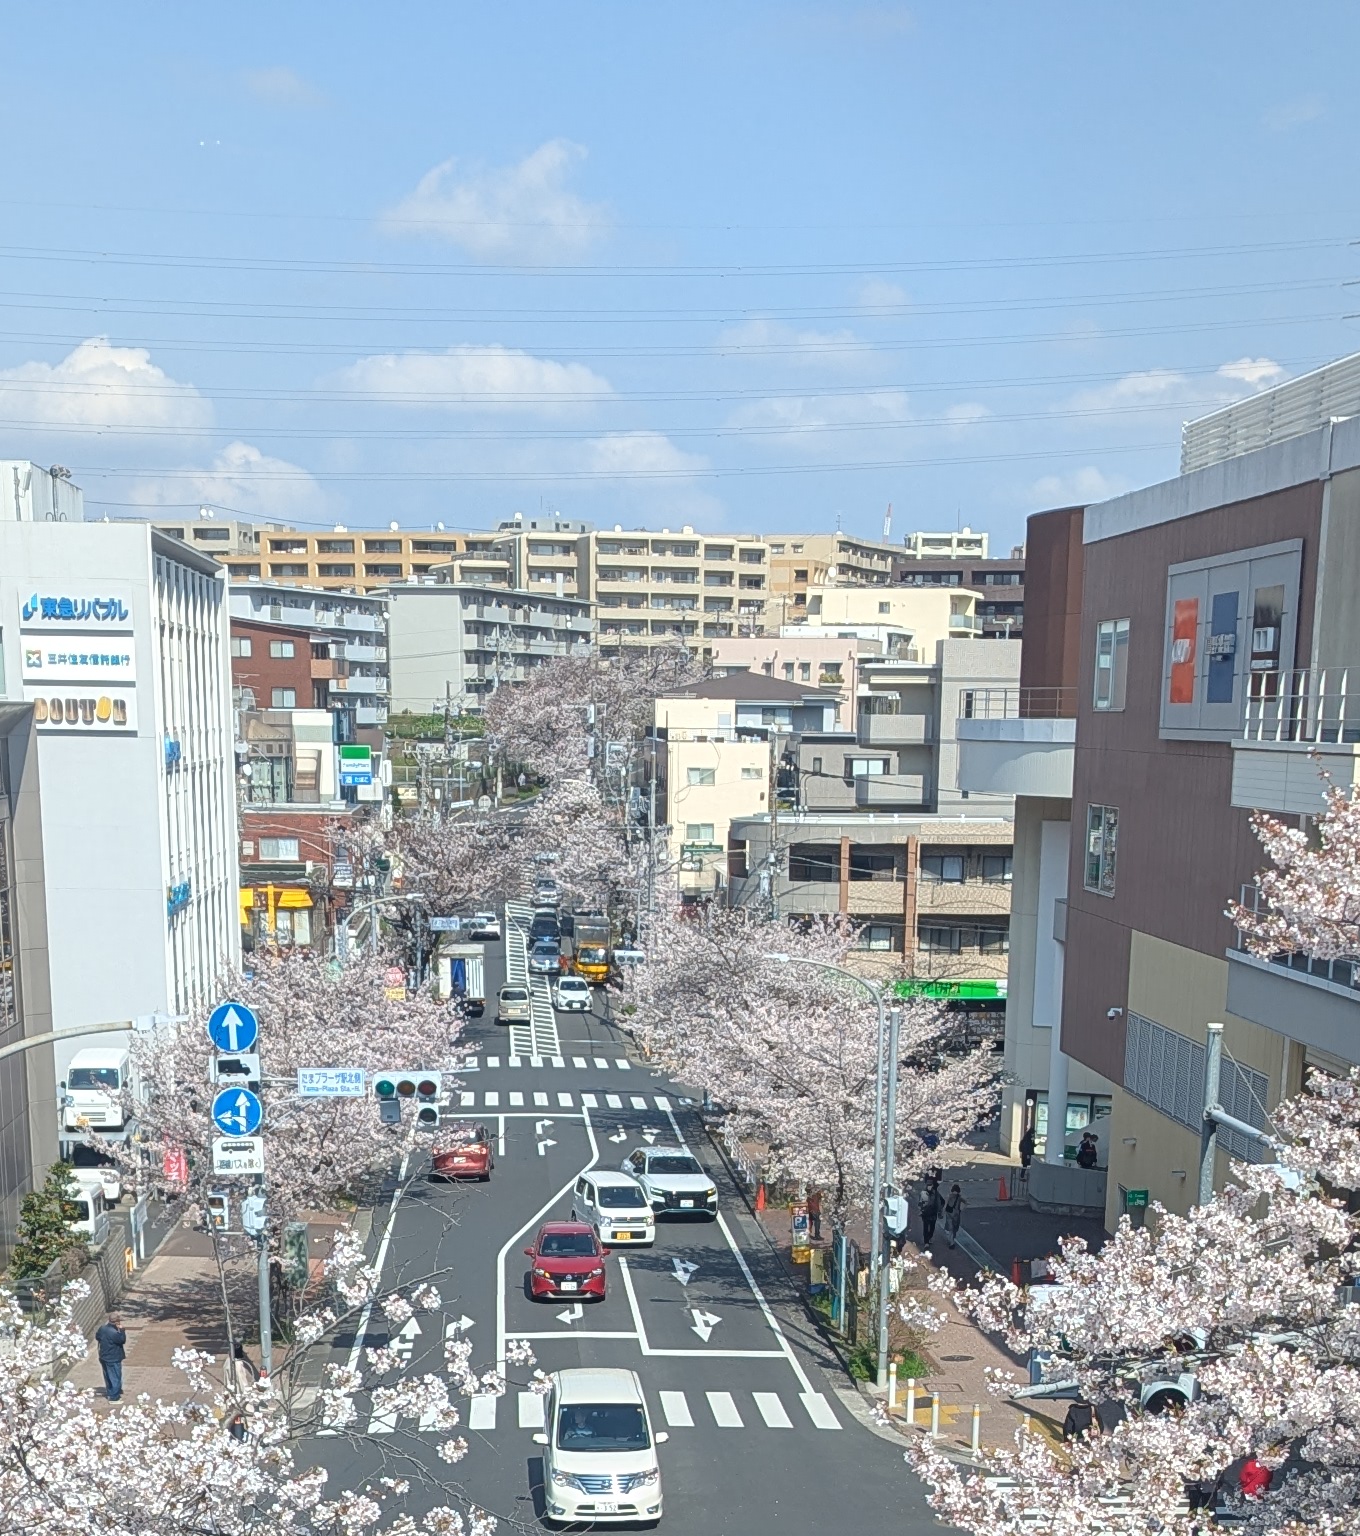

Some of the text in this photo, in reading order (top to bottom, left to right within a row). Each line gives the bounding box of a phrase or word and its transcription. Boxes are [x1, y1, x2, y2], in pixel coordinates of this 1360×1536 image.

[40, 597, 129, 621] 東急リバブル
[47, 653, 130, 667] 三井住友信託銀行
[33, 696, 127, 725] DOUTOR
[301, 1072, 361, 1085] たまプラーザ駅北側
